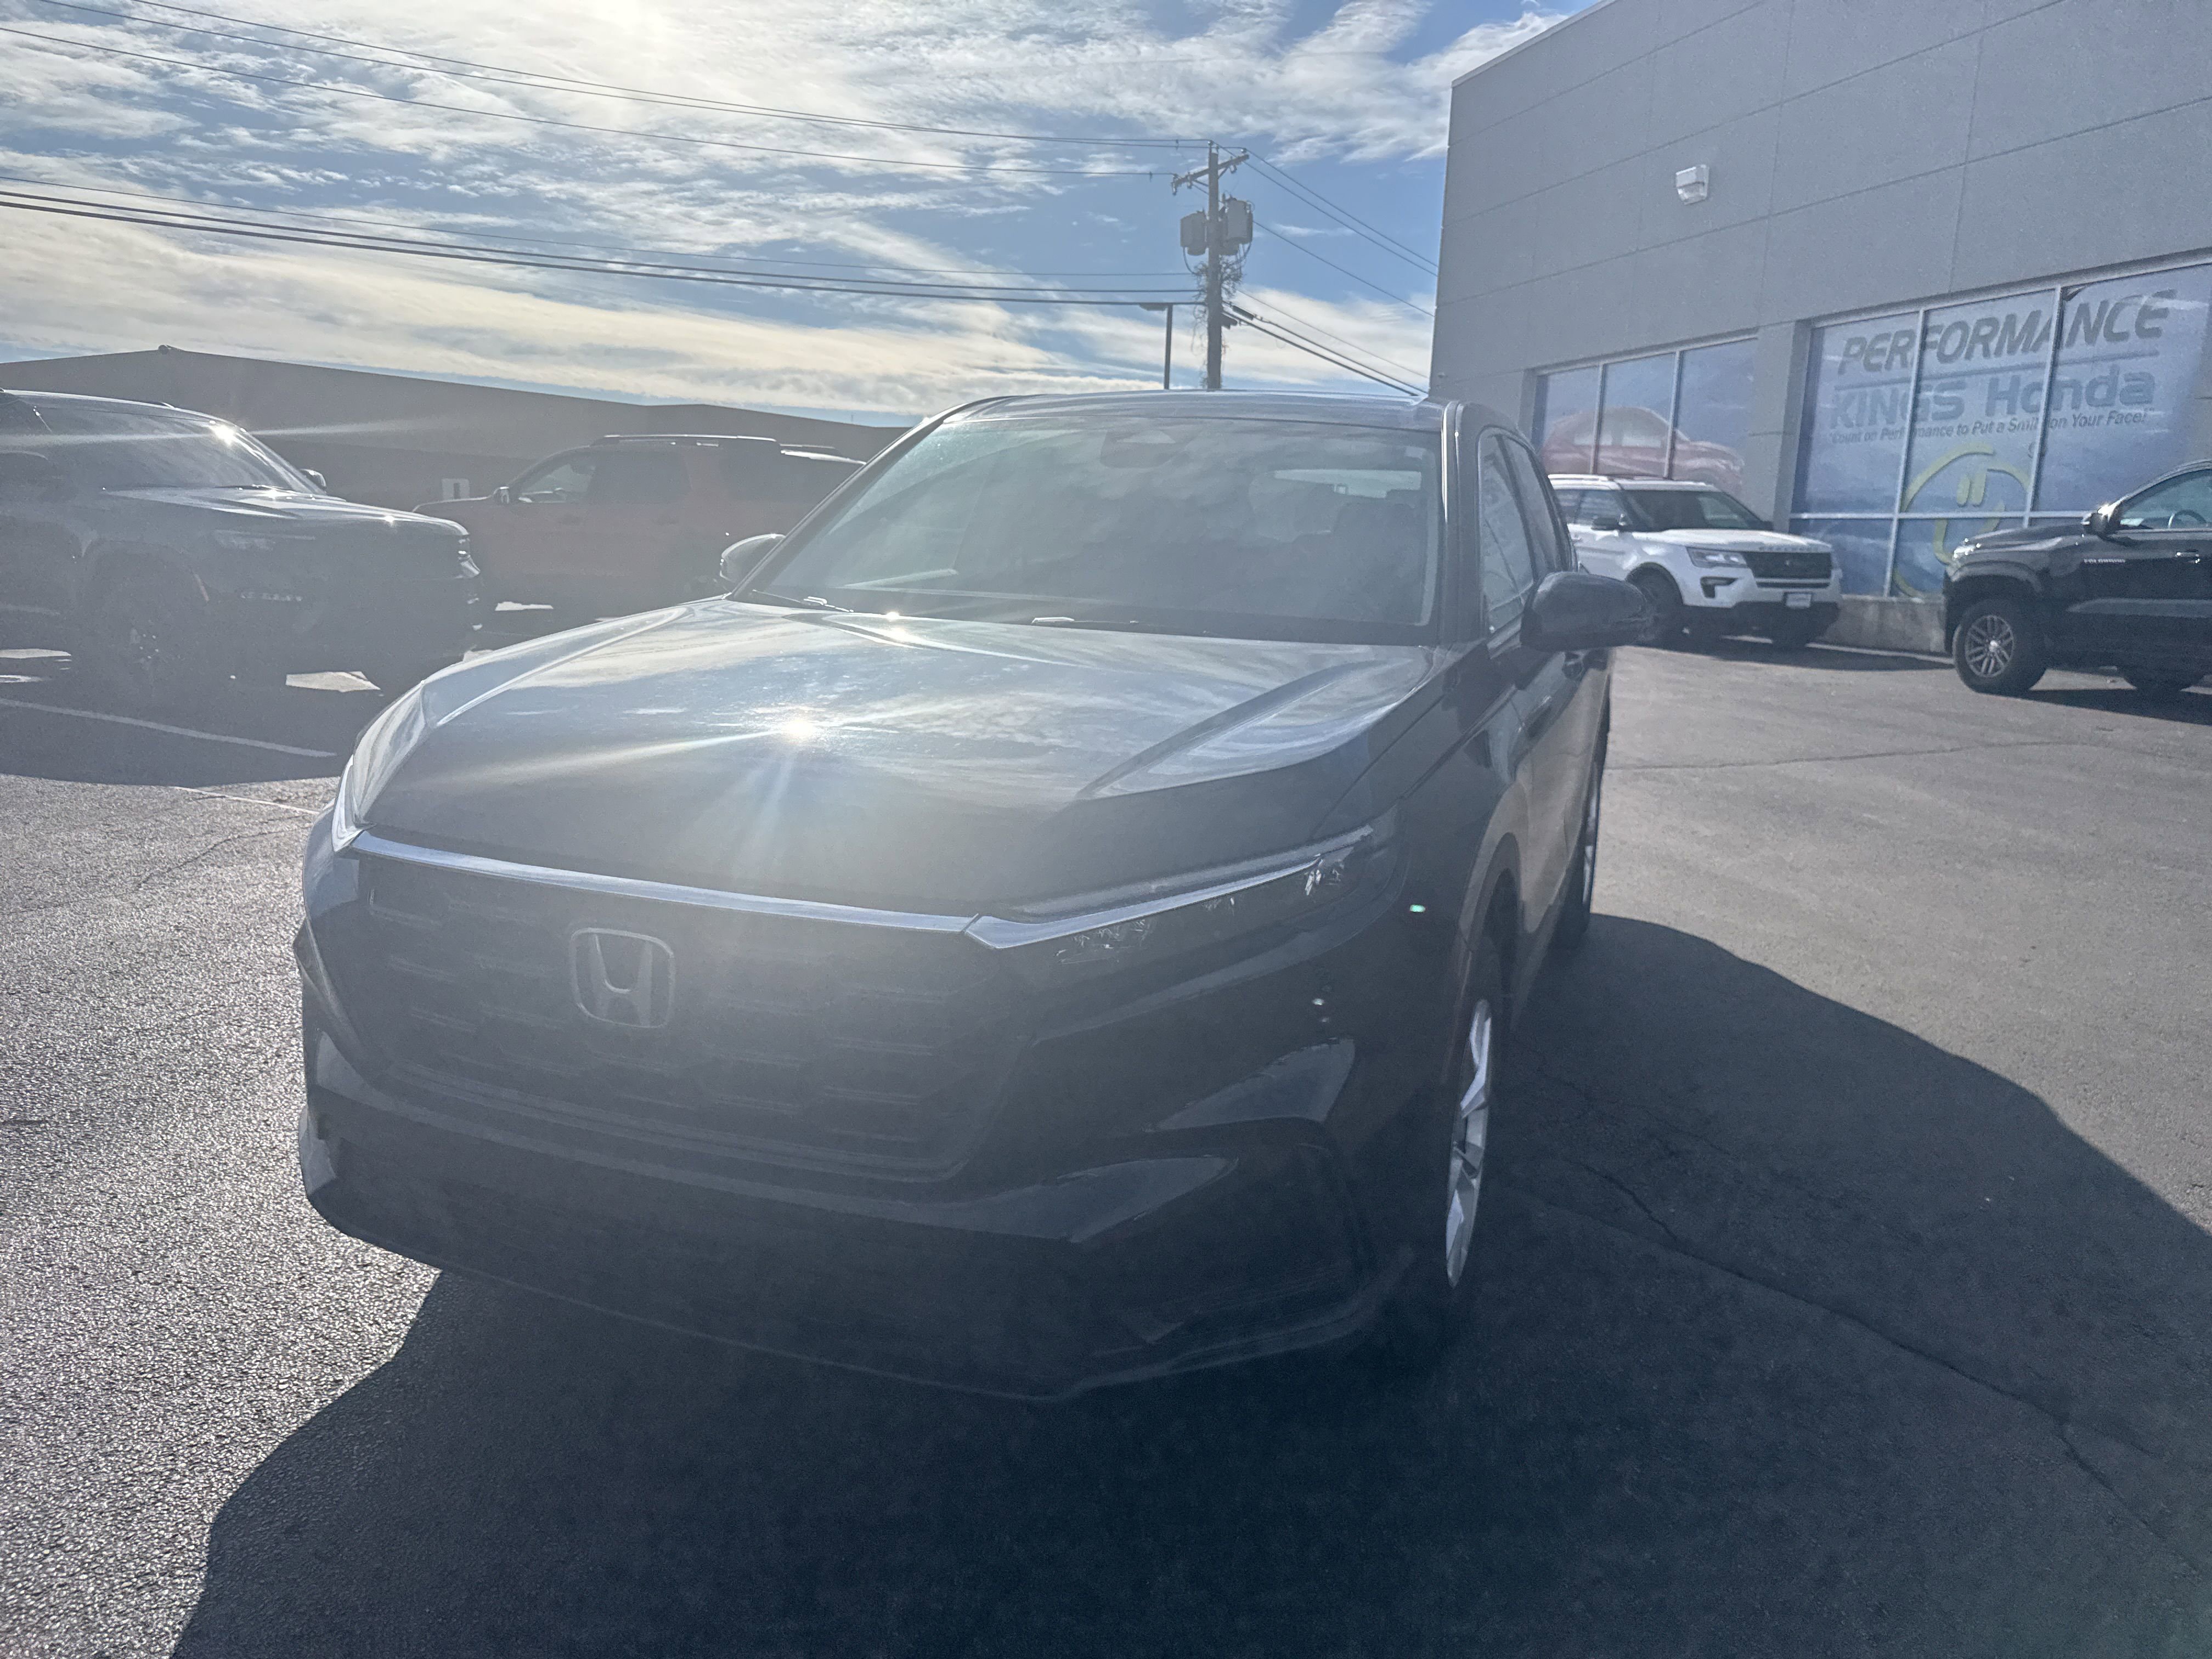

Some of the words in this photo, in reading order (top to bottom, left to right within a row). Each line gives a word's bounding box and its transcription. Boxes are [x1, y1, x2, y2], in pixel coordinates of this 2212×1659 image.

[1838, 289, 2177, 375] PERFORMANCE
[1830, 380, 1966, 428] KINGS
[1985, 364, 2155, 416] Honda
[1956, 423, 1968, 436] to
[1972, 420, 1994, 435] Put
[1995, 421, 2004, 433] a
[2050, 417, 2067, 430] on
[2072, 412, 2103, 428] Your
